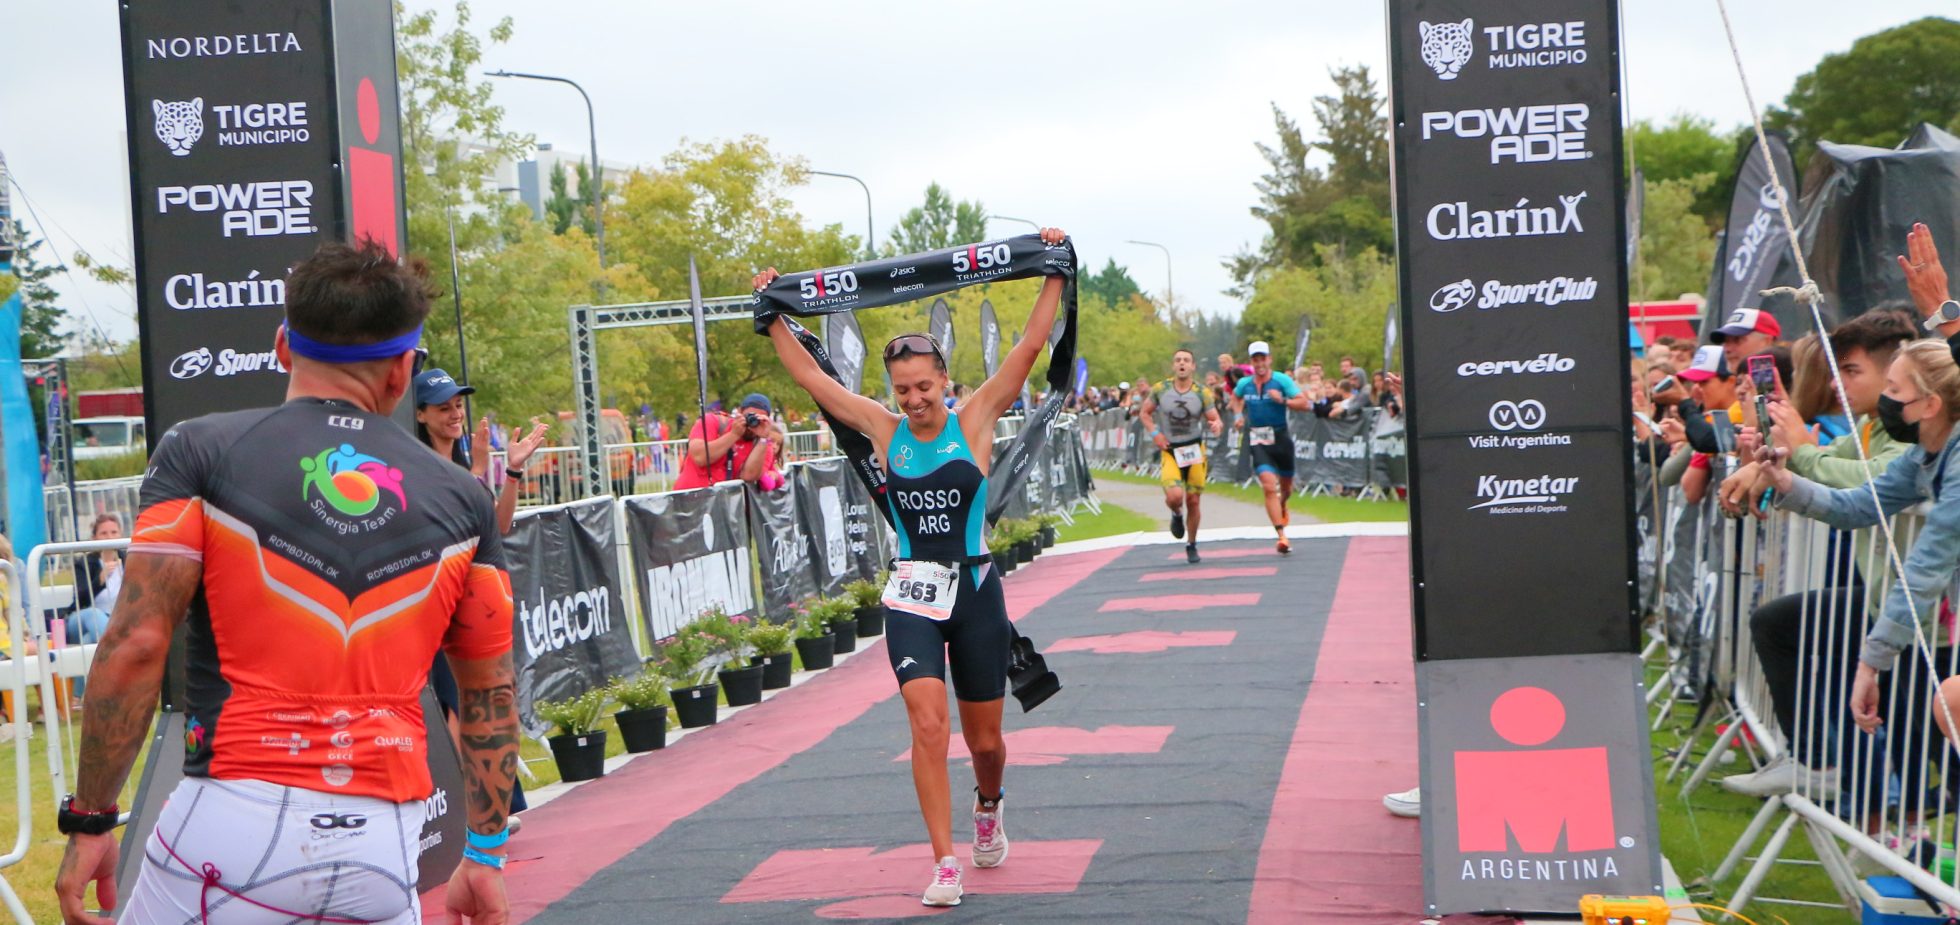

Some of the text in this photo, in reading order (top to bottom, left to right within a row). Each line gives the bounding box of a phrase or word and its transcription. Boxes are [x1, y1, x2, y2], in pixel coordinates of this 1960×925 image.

[148, 32, 302, 59] NORDELTA
[1484, 21, 1585, 51] TIGRE
[1489, 49, 1587, 69] MUNICIPIO
[212, 102, 308, 129] TIGRE
[1422, 103, 1590, 140] POWER
[219, 129, 310, 146] MUNICIPIO
[158, 180, 313, 213] POWER
[1426, 197, 1559, 241] Clarín
[898, 266, 915, 275] asics
[956, 267, 1012, 281] TRIATHLON
[165, 270, 285, 310] Clarín
[893, 282, 924, 294] telecom
[1478, 277, 1597, 309] SportClub
[802, 294, 859, 308] TRIATHLON
[215, 349, 288, 376] Sport
[1457, 353, 1575, 376] cervélo
[328, 415, 364, 430] CC9
[1468, 433, 1571, 449] Visit Argentina
[897, 489, 960, 510] ROSSO
[1477, 474, 1578, 501] Kynetar
[310, 499, 396, 534] Sinergia Team
[1490, 505, 1567, 514] Medicina del Deporte
[918, 514, 950, 534] ARG
[898, 580, 938, 602] 963
[520, 586, 610, 659] telecom
[1461, 856, 1619, 881] ARGENTINA
